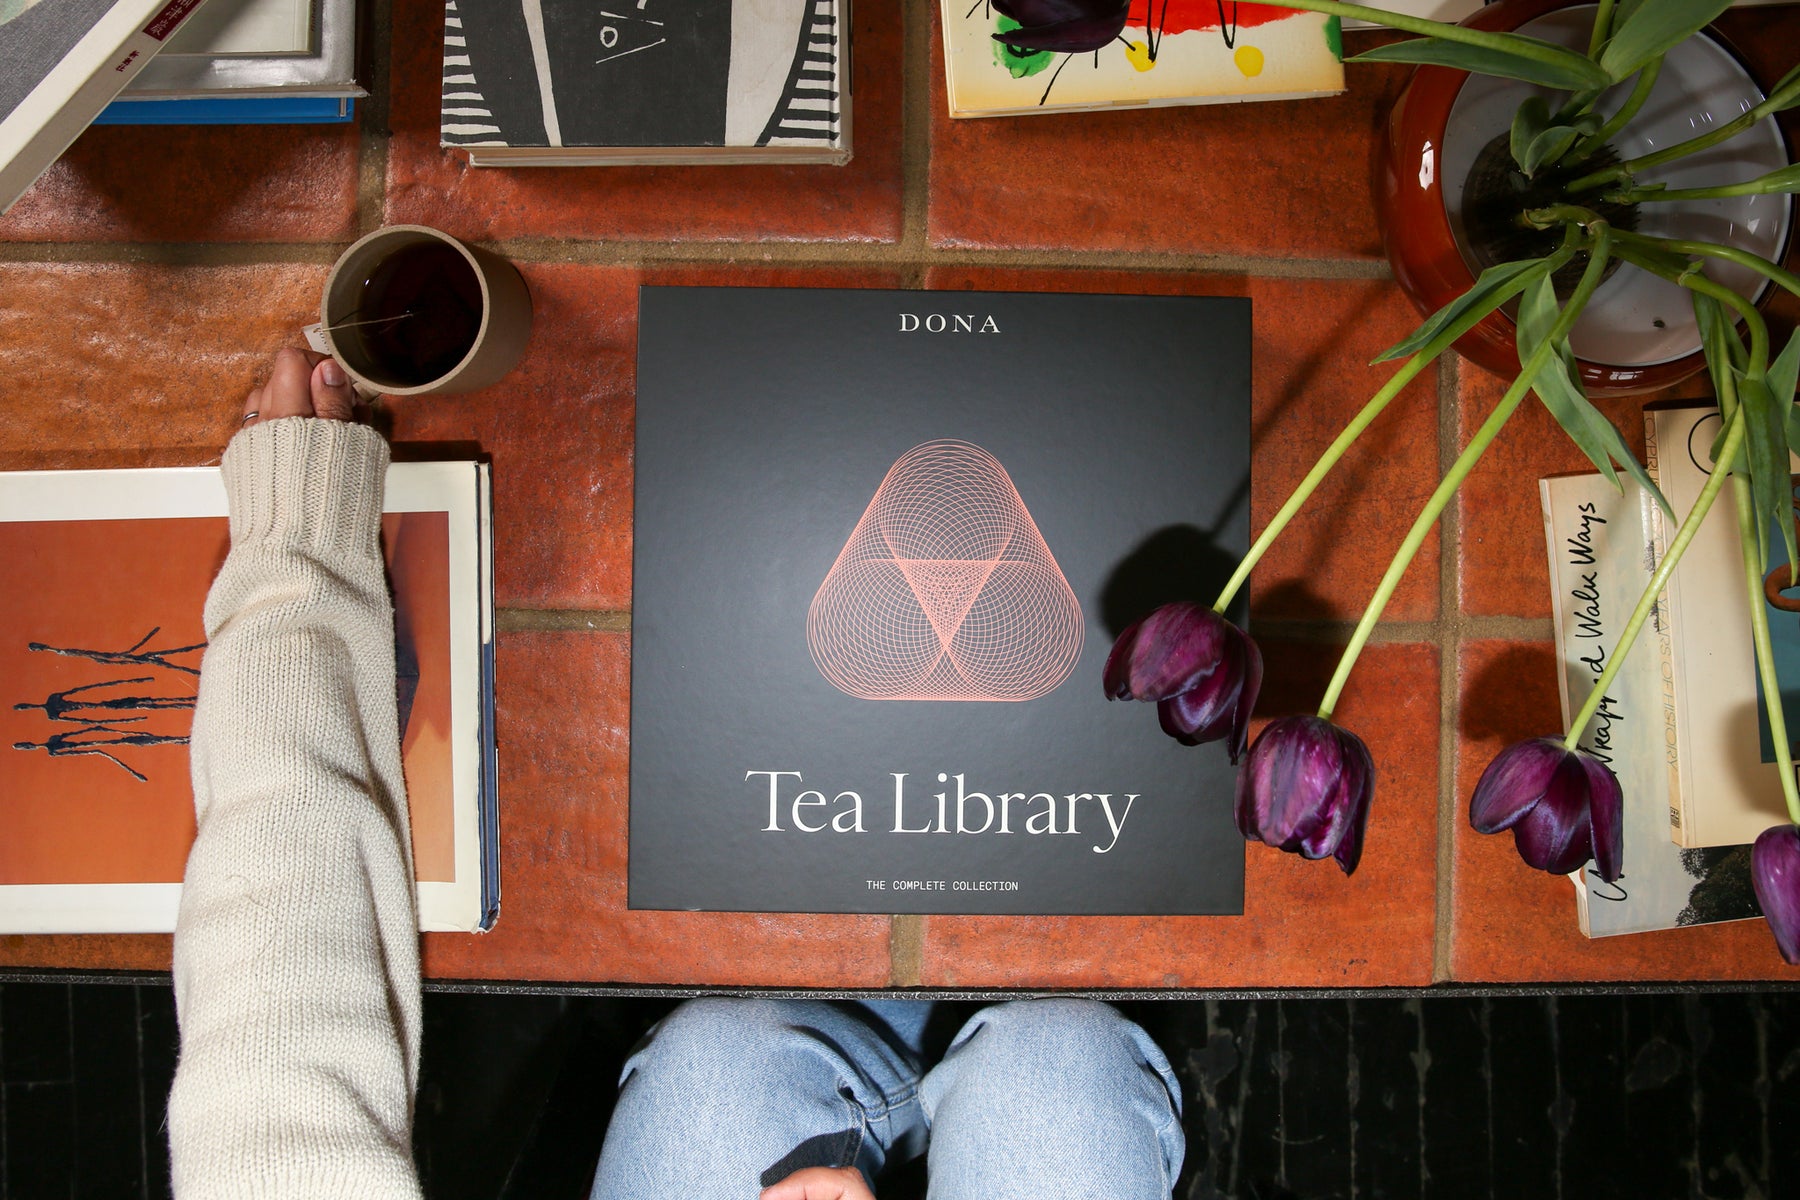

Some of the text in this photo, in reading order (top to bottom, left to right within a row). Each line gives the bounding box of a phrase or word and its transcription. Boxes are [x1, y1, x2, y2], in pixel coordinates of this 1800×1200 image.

[899, 313, 1001, 333] DONA
[1567, 502, 1624, 774] Wrappd Walk Ways
[1657, 598, 1672, 656] YEARS
[1661, 661, 1674, 690] OF
[1663, 693, 1679, 773] HISTORY
[744, 770, 1142, 853] Tea Library
[866, 880, 1019, 891] THE COMPLETE COLLECTION
